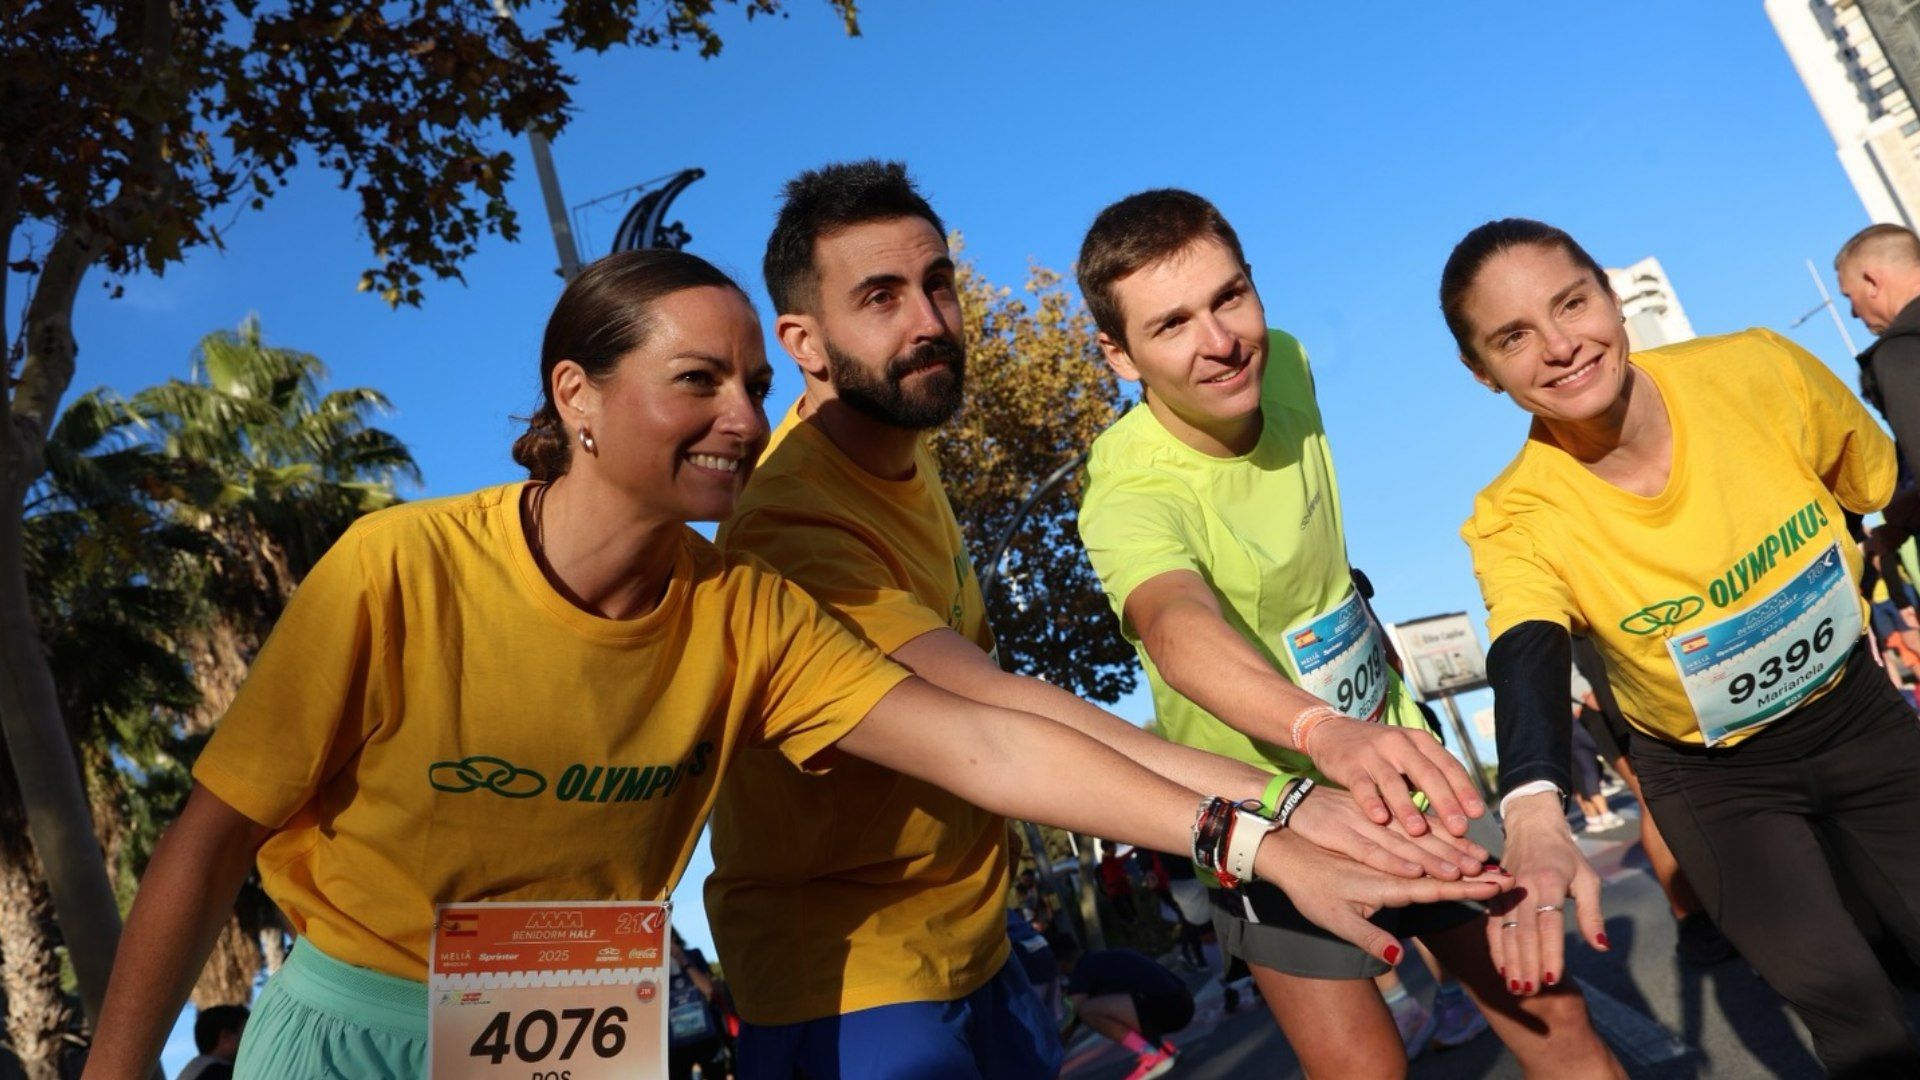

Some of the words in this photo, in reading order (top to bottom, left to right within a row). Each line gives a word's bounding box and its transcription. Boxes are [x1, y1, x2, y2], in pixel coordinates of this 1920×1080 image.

[1708, 499, 1828, 608] OLYMPIKUS
[1337, 643, 1382, 714] 9019
[1728, 617, 1835, 705] 9396
[1757, 662, 1824, 708] Marianela
[479, 952, 520, 962] Sprinter
[538, 950, 570, 963] 2025
[512, 930, 567, 940] BENIDORM
[569, 929, 597, 939] HALF
[470, 1006, 628, 1065] 4076
